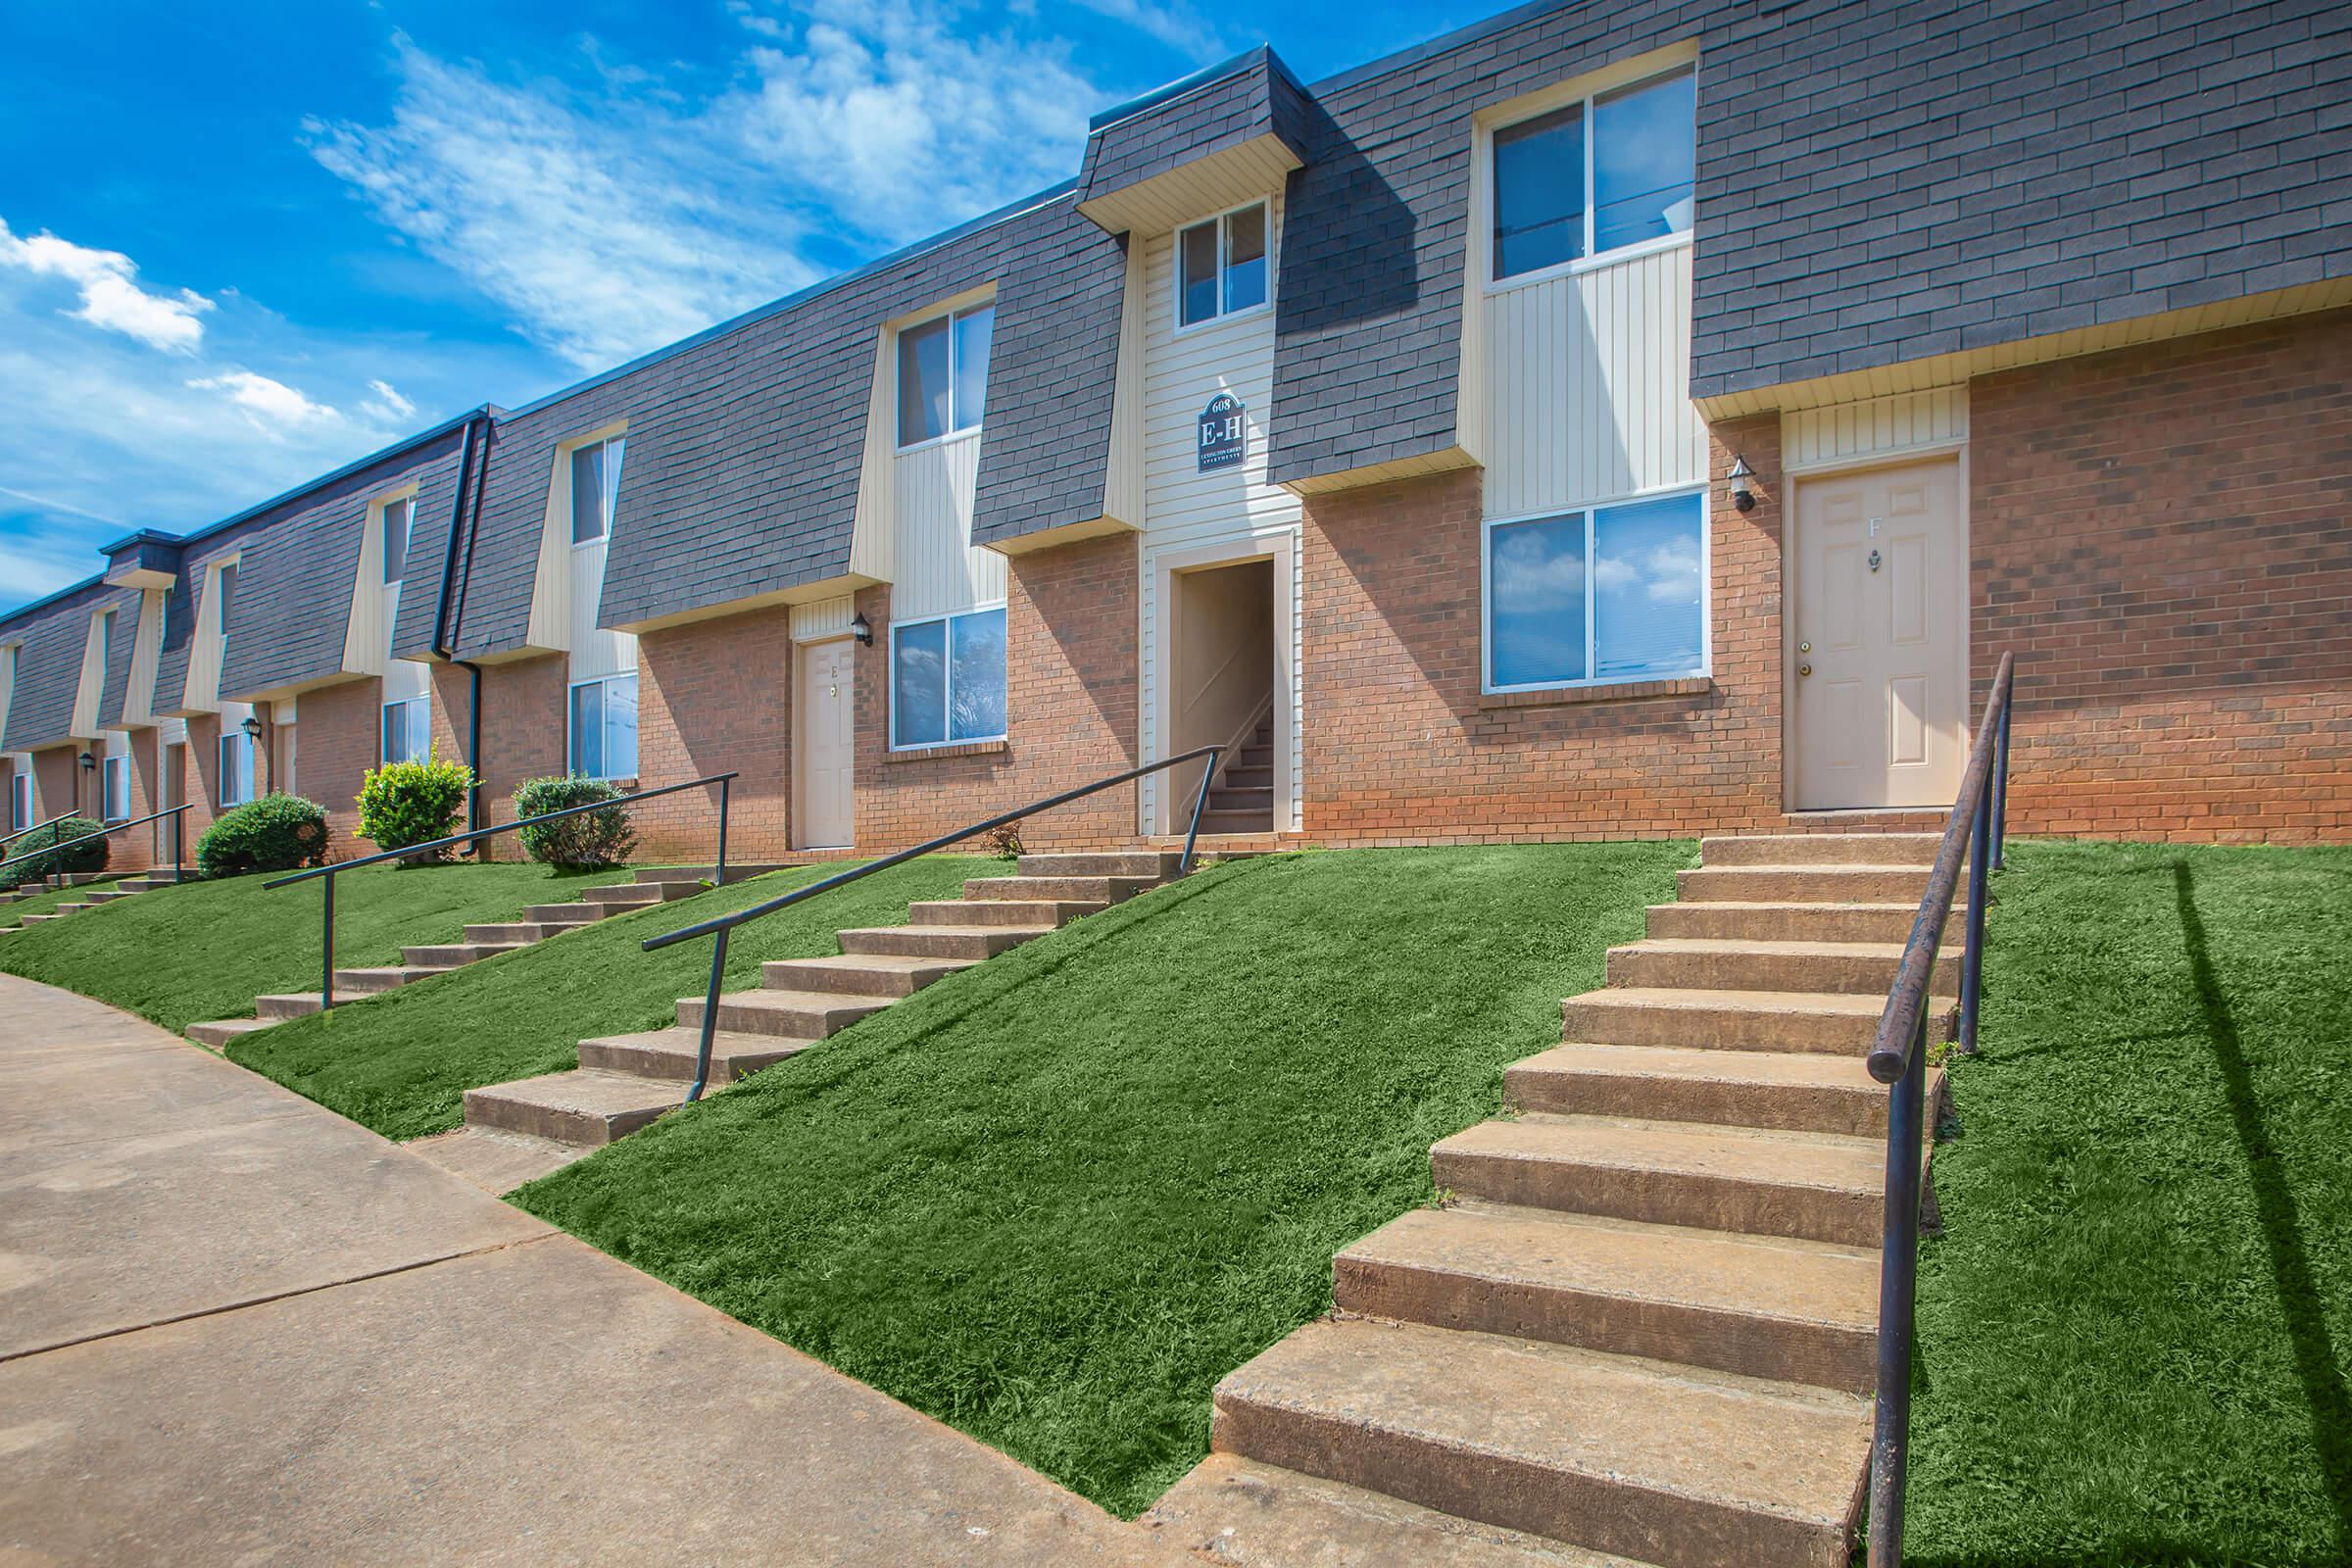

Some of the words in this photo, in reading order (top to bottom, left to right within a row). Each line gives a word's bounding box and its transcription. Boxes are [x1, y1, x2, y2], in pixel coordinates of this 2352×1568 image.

[1212, 398, 1231, 414] 608
[1201, 416, 1242, 446] E-H
[1203, 453, 1240, 464] APARTMENTS
[1870, 516, 1882, 537] F
[831, 665, 839, 678] E
